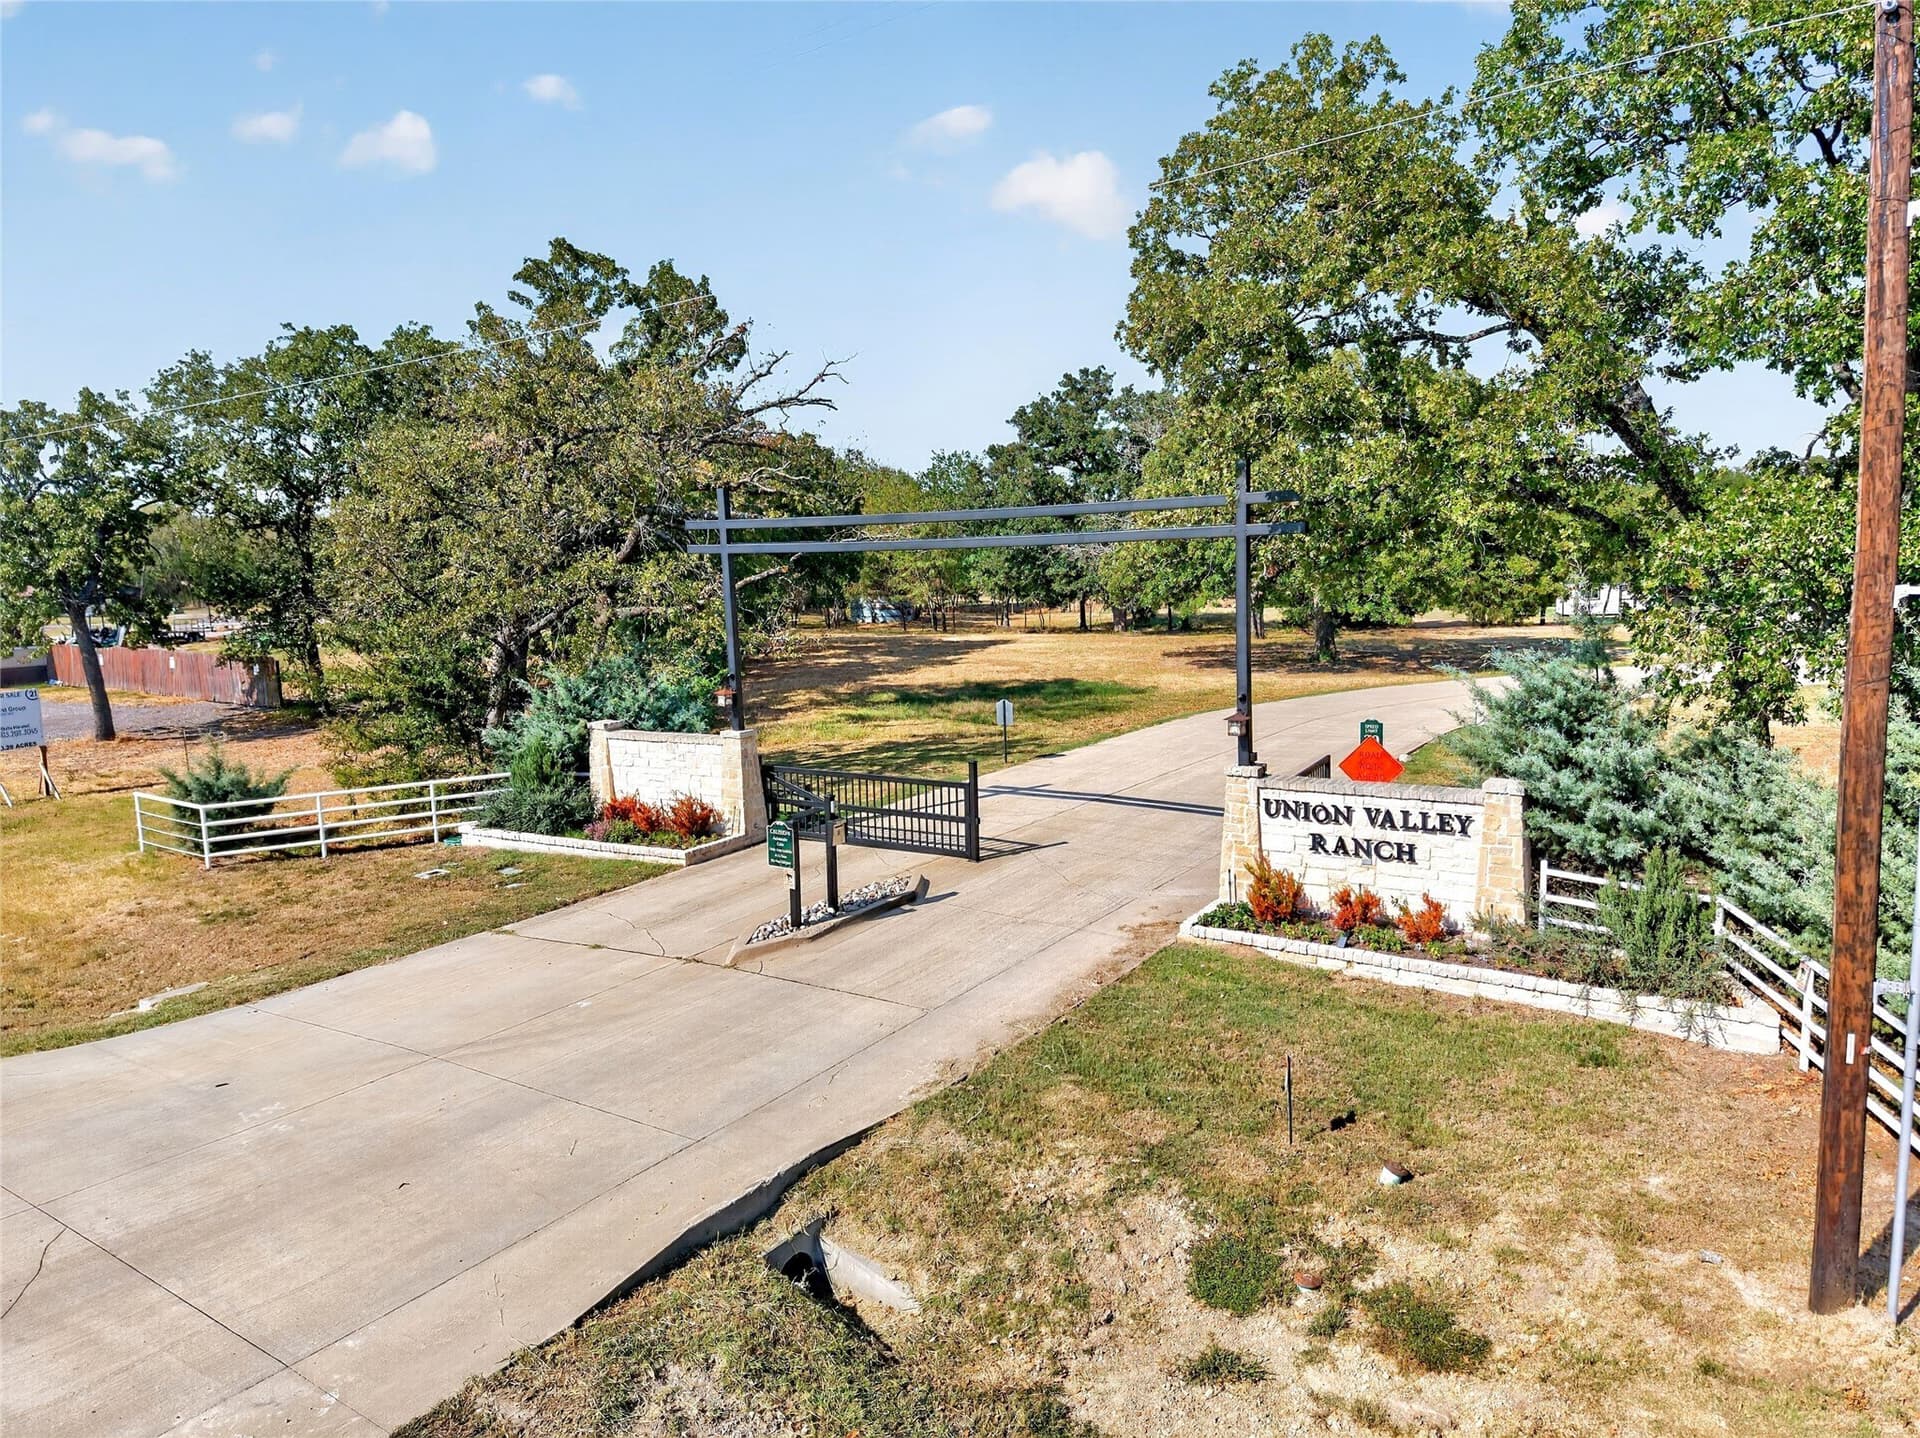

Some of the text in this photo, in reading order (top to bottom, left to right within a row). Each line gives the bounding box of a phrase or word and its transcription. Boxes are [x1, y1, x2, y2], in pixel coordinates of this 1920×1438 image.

[1262, 798, 1474, 837] UNION VALLEY
[1308, 833, 1418, 864] RANCH
